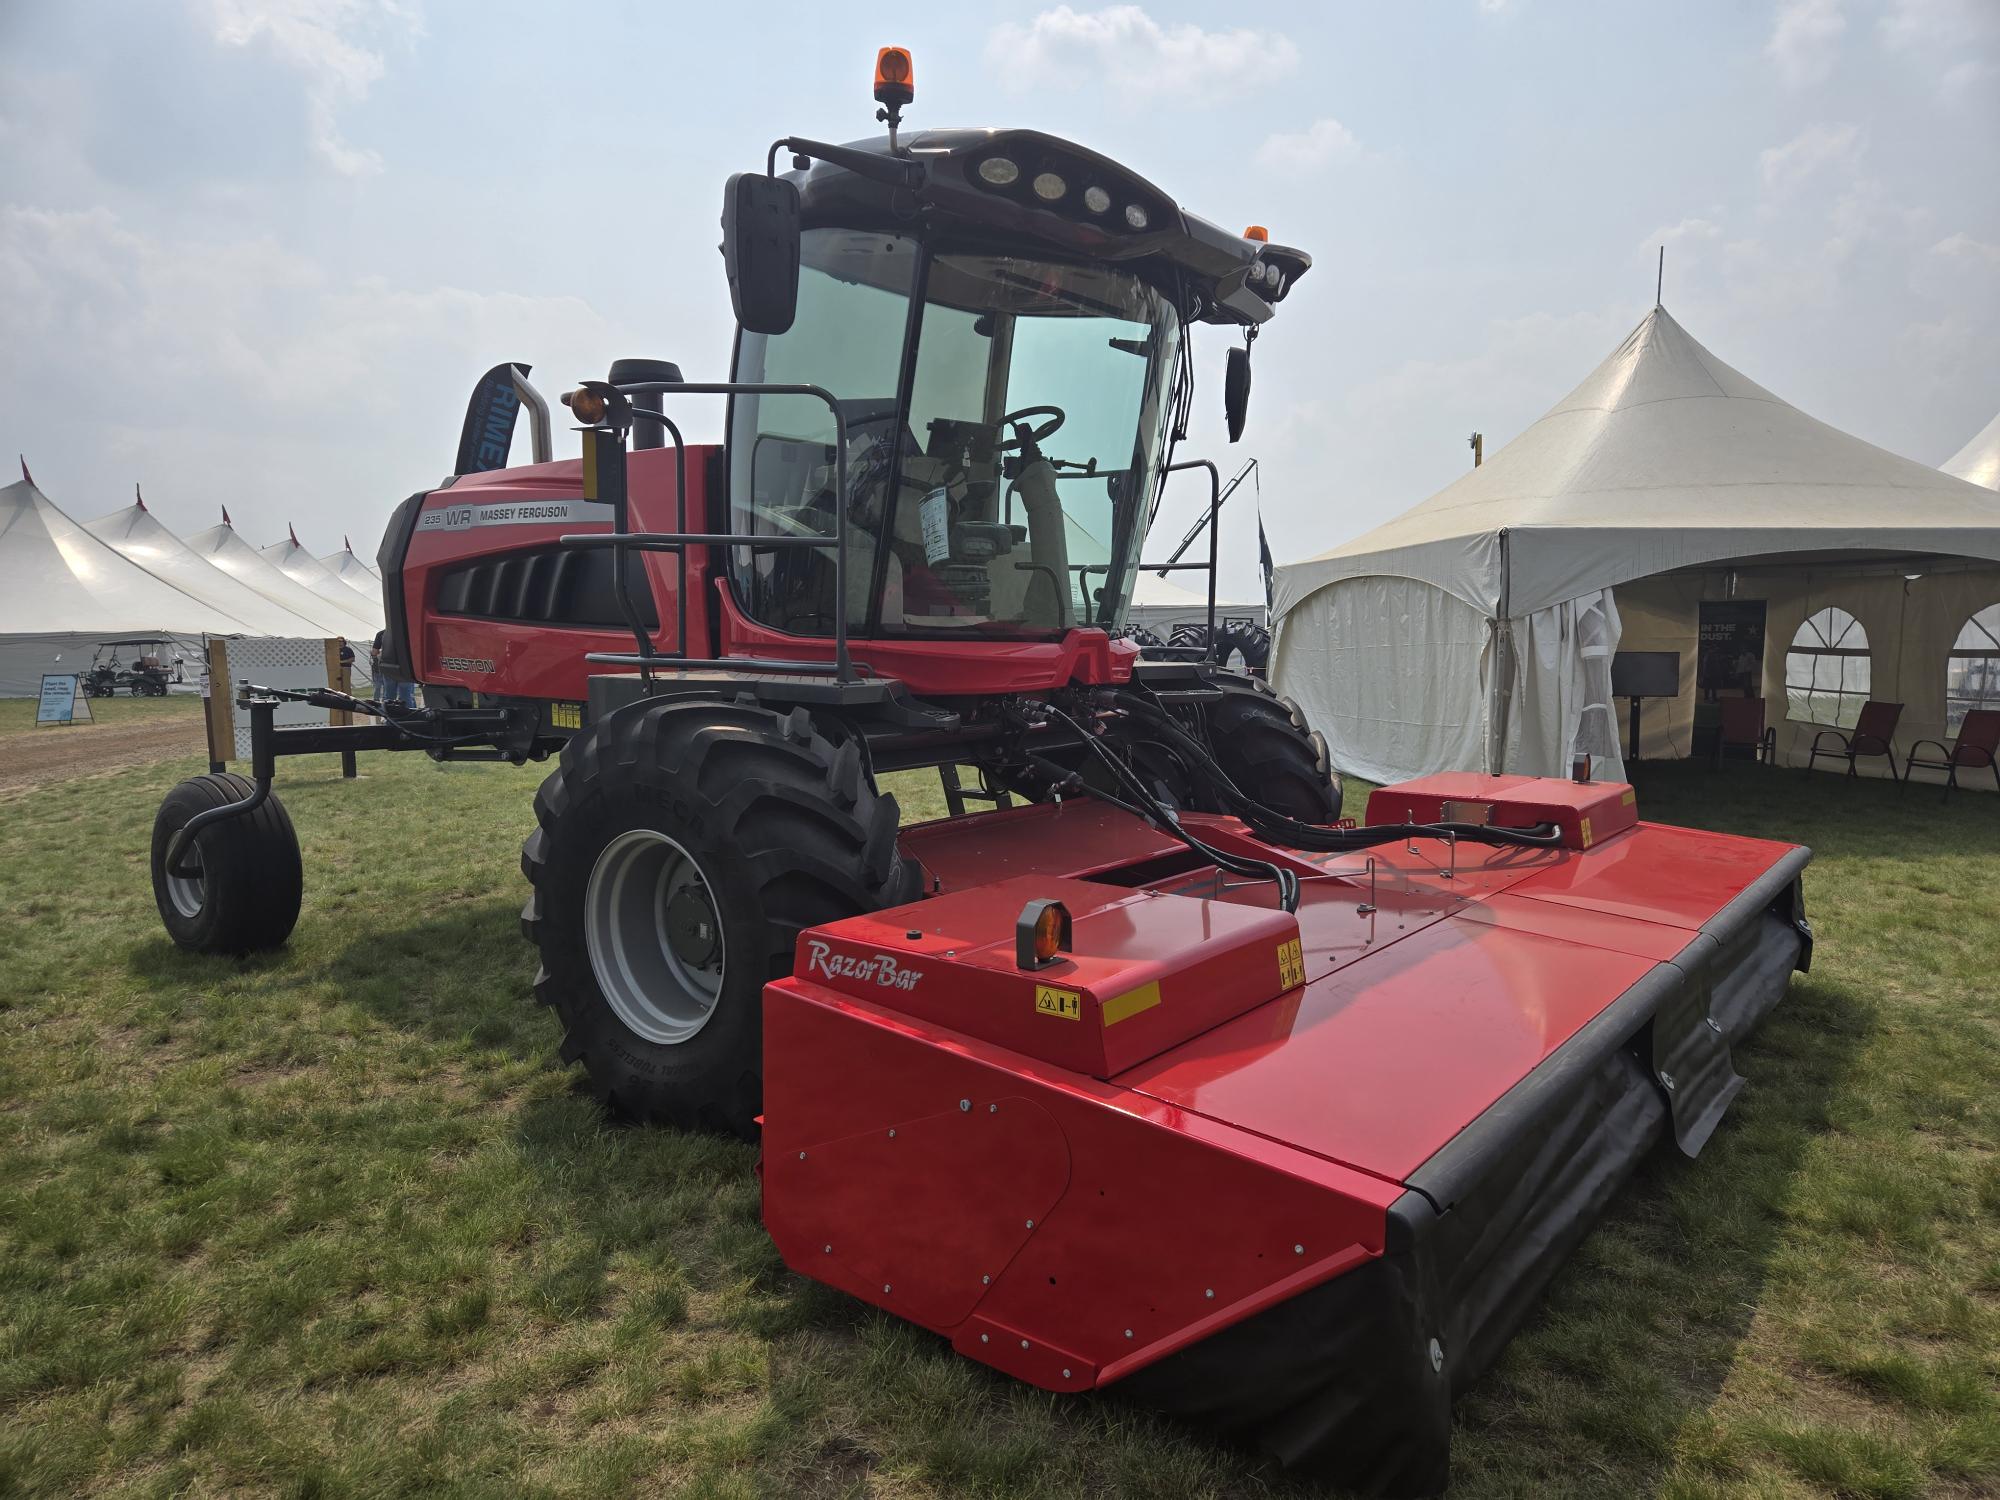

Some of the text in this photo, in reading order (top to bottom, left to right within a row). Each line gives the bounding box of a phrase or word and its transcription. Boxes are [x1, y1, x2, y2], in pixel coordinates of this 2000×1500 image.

[476, 383, 516, 470] RIME
[424, 510, 472, 526] 235 WR
[480, 506, 568, 521] MASSEY FERGUSON
[1701, 624, 1737, 632] IN THE
[1701, 632, 1733, 641] DUST.
[439, 656, 496, 674] HESSTON
[807, 940, 924, 992] RazorBar
